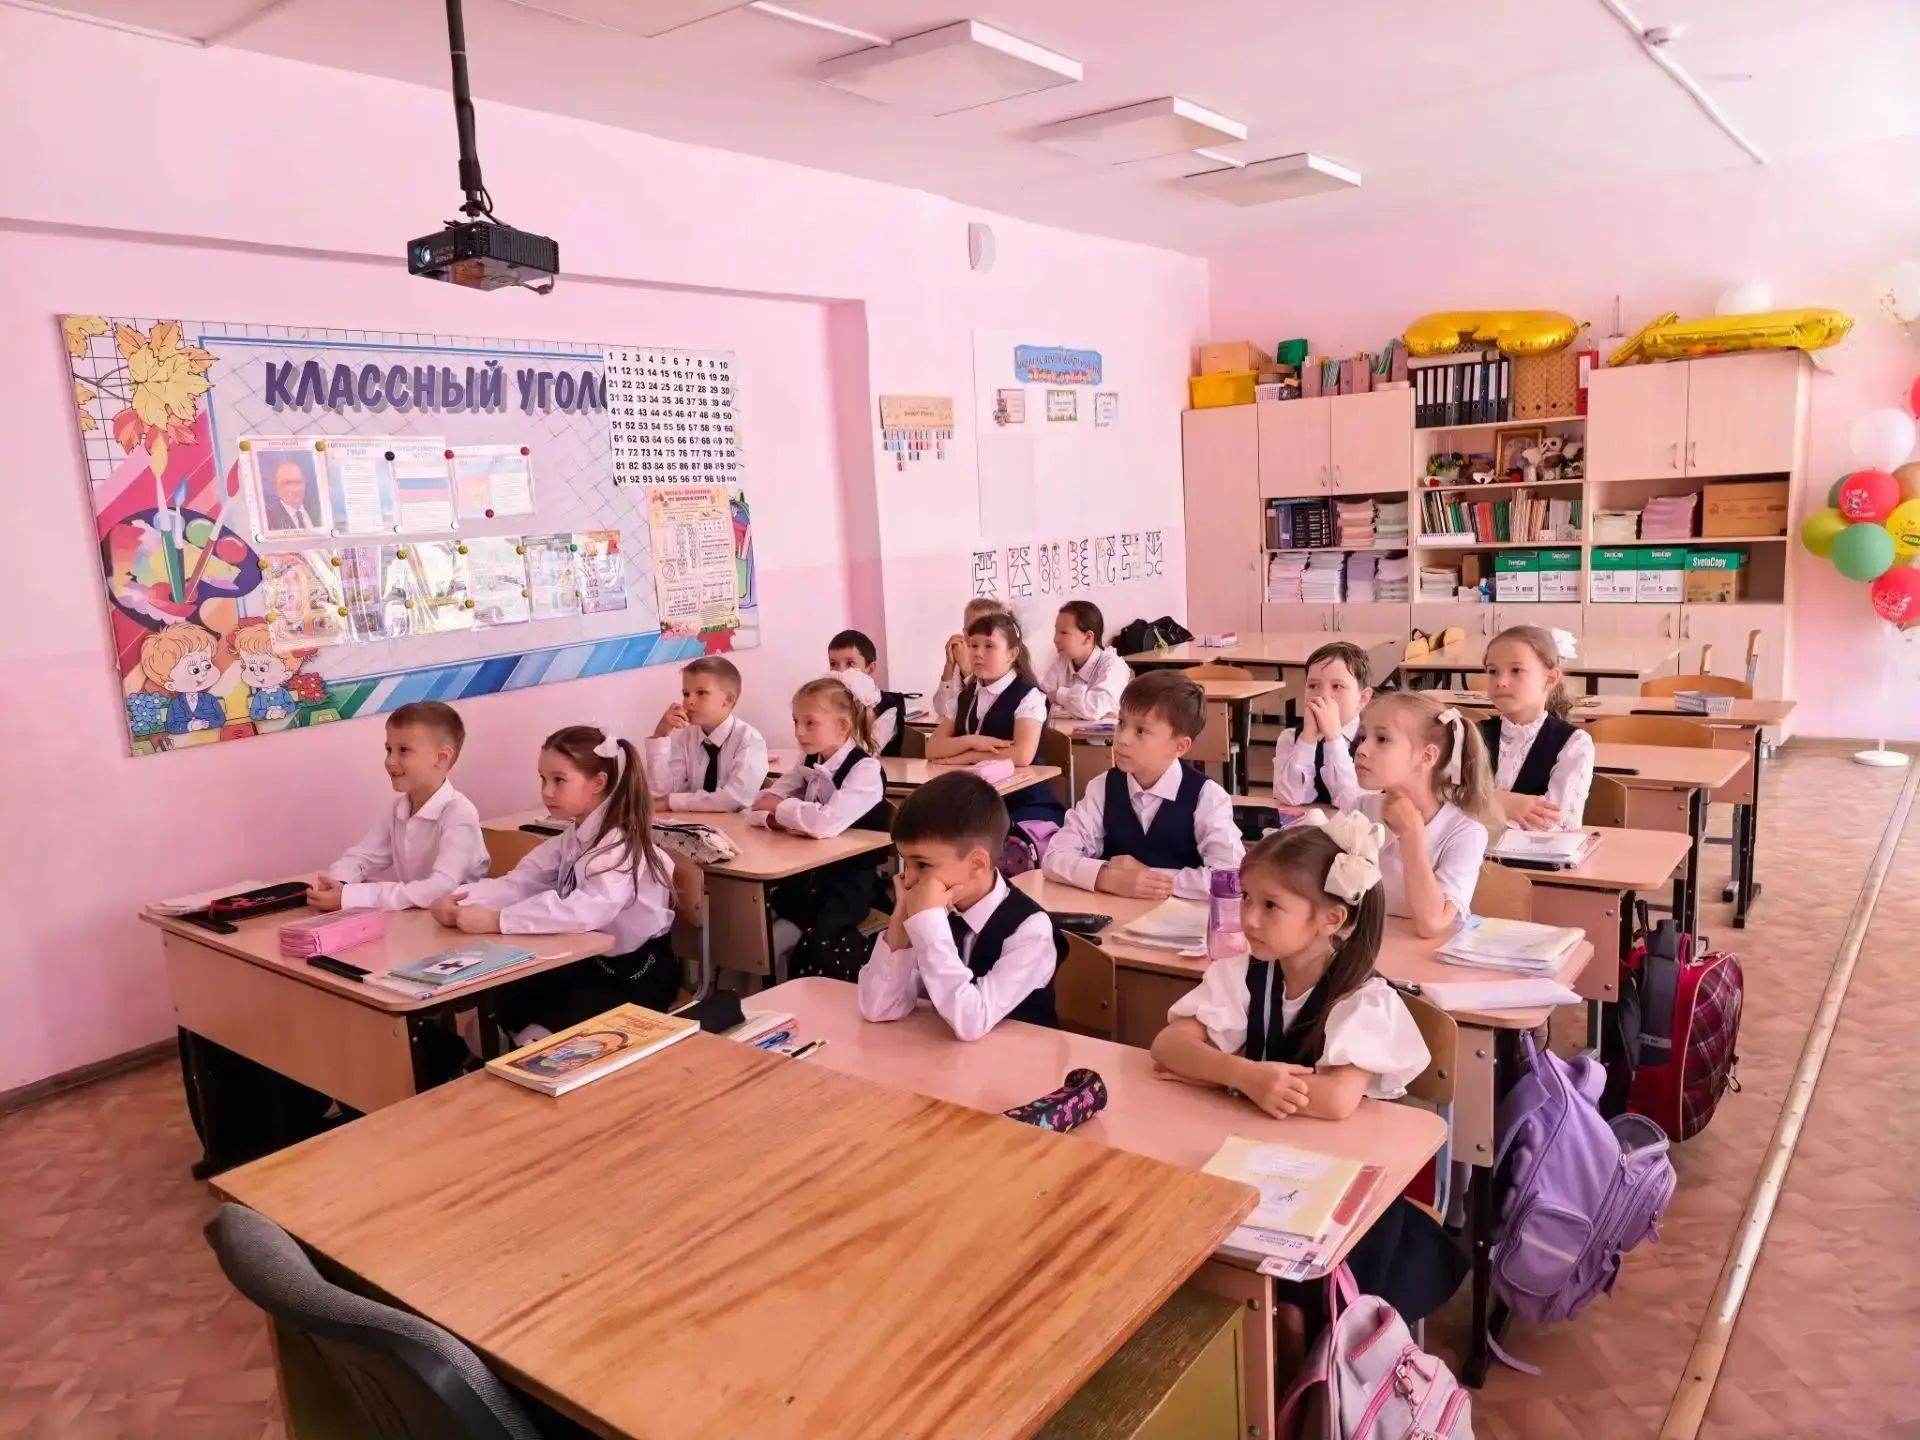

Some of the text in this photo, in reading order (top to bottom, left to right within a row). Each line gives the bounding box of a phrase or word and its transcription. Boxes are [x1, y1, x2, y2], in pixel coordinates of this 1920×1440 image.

[622, 353, 627, 361] 2
[635, 354, 640, 362] 3
[661, 356, 666, 364] 5
[621, 366, 631, 375] 12
[660, 369, 670, 378] 15
[685, 372, 694, 380] 17
[696, 372, 706, 380] 18
[709, 373, 717, 381] 19
[720, 374, 729, 382] 20
[265, 360, 506, 412] КЛАССНЫЙ
[608, 379, 618, 388] 21
[622, 380, 632, 388] 22
[636, 381, 645, 389] 23
[648, 382, 658, 390] 24
[685, 384, 695, 392] 27
[697, 385, 706, 393] 28
[710, 386, 718, 394] 29
[610, 393, 619, 401] 31
[623, 394, 633, 402] 32
[698, 398, 707, 406] 38
[624, 408, 634, 416] 42
[637, 408, 647, 416] 43
[663, 410, 673, 418] 45
[612, 421, 621, 429] 51
[625, 422, 635, 430] 52
[638, 422, 648, 430] 53
[614, 435, 623, 443] 61
[627, 435, 637, 443] 62
[652, 436, 662, 444] 64
[701, 437, 710, 445] 68
[615, 448, 624, 456] 71
[641, 449, 650, 457] 73
[653, 448, 663, 457] 74
[616, 462, 625, 470] 81
[628, 462, 639, 470] 82
[642, 462, 652, 470] 83
[654, 462, 664, 471] 84
[667, 462, 676, 470] 85
[630, 475, 640, 483] 92
[643, 475, 653, 483] 93
[655, 475, 665, 483] 94
[668, 475, 677, 483] 95
[1692, 557, 1727, 568] SvetoCopy
